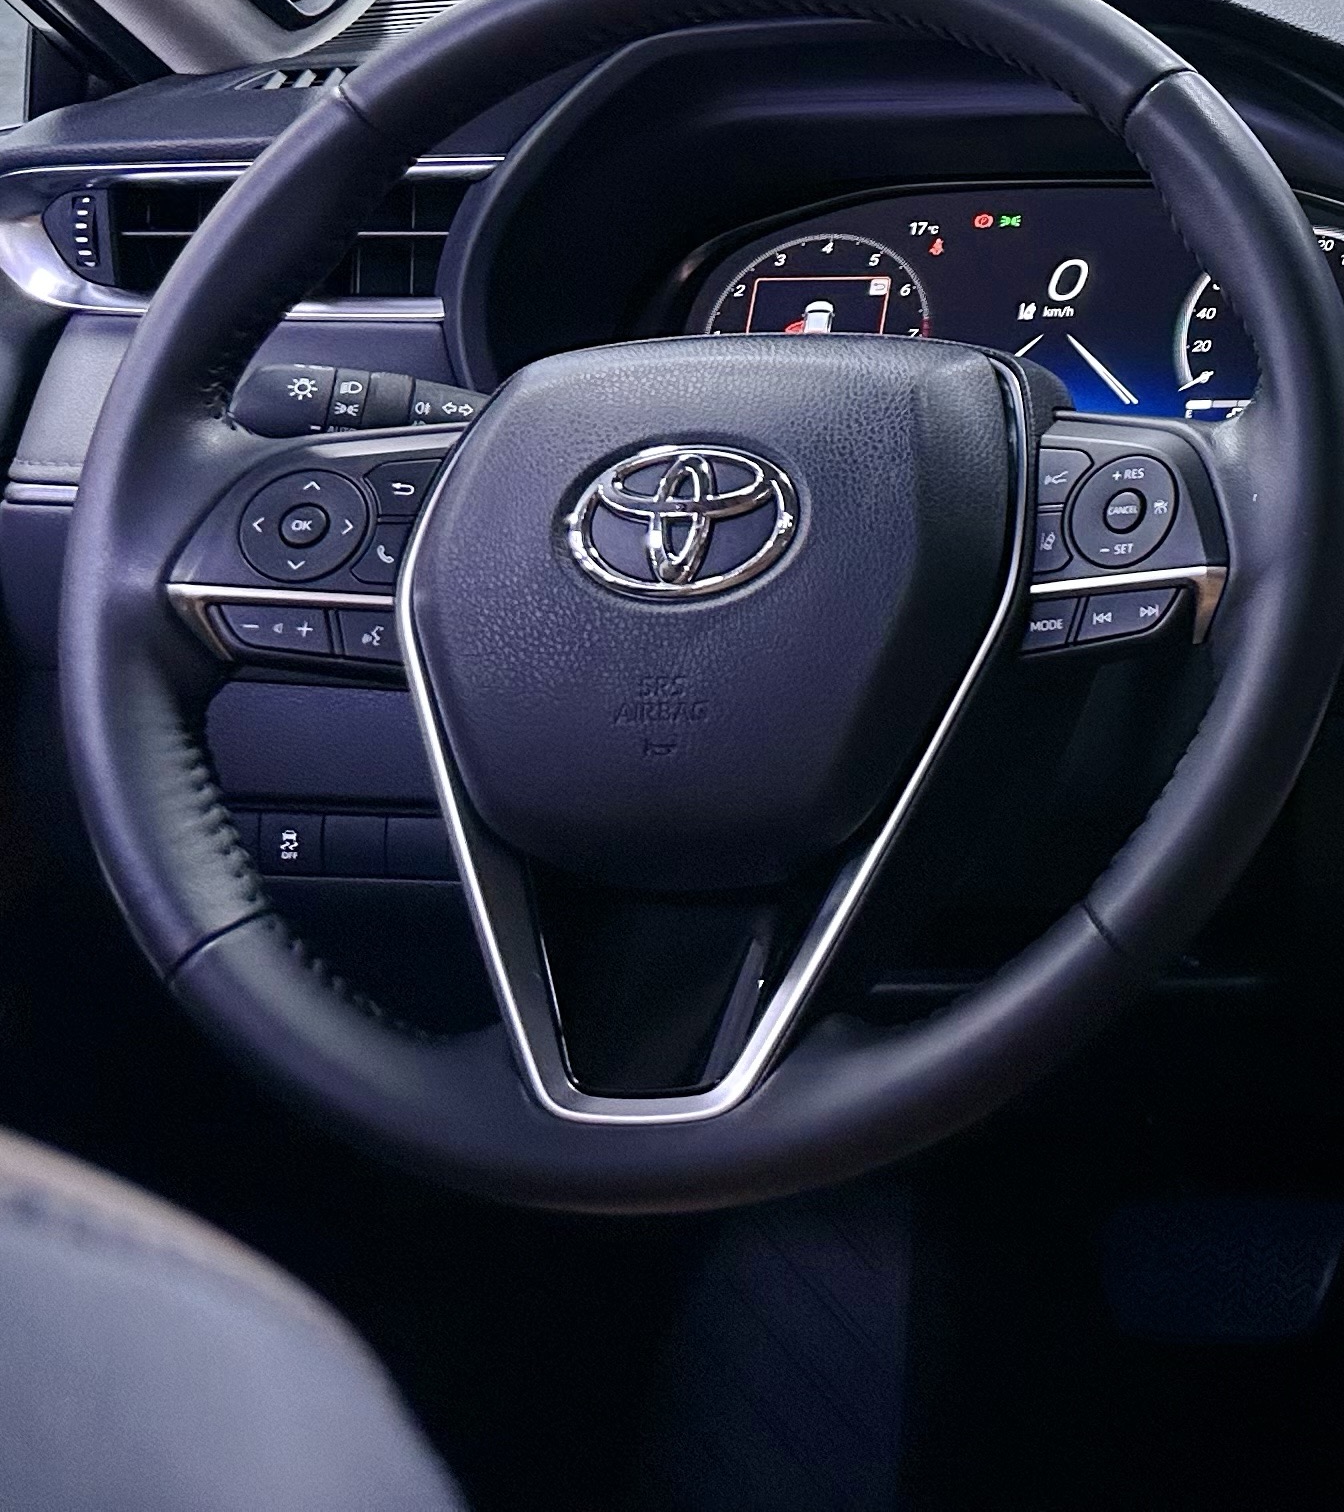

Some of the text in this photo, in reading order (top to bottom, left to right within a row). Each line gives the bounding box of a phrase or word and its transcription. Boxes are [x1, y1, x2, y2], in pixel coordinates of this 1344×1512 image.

[821, 241, 834, 254] 4
[1318, 239, 1335, 252] 20
[774, 253, 786, 267] 3
[869, 253, 881, 266] 5
[1048, 258, 1089, 302] 0
[733, 284, 746, 297] 2
[899, 284, 911, 296] 6
[1042, 305, 1075, 318] km/h
[1196, 307, 1217, 320] 40
[1191, 339, 1212, 353] 20
[1184, 409, 1193, 419] E
[1123, 467, 1145, 481] RES
[1107, 503, 1139, 516] CANCEL
[291, 519, 312, 531] OK
[1113, 542, 1134, 555] SET
[1030, 617, 1063, 632] MODE
[613, 699, 710, 724] AIRBAG
[281, 851, 298, 860] OFF
